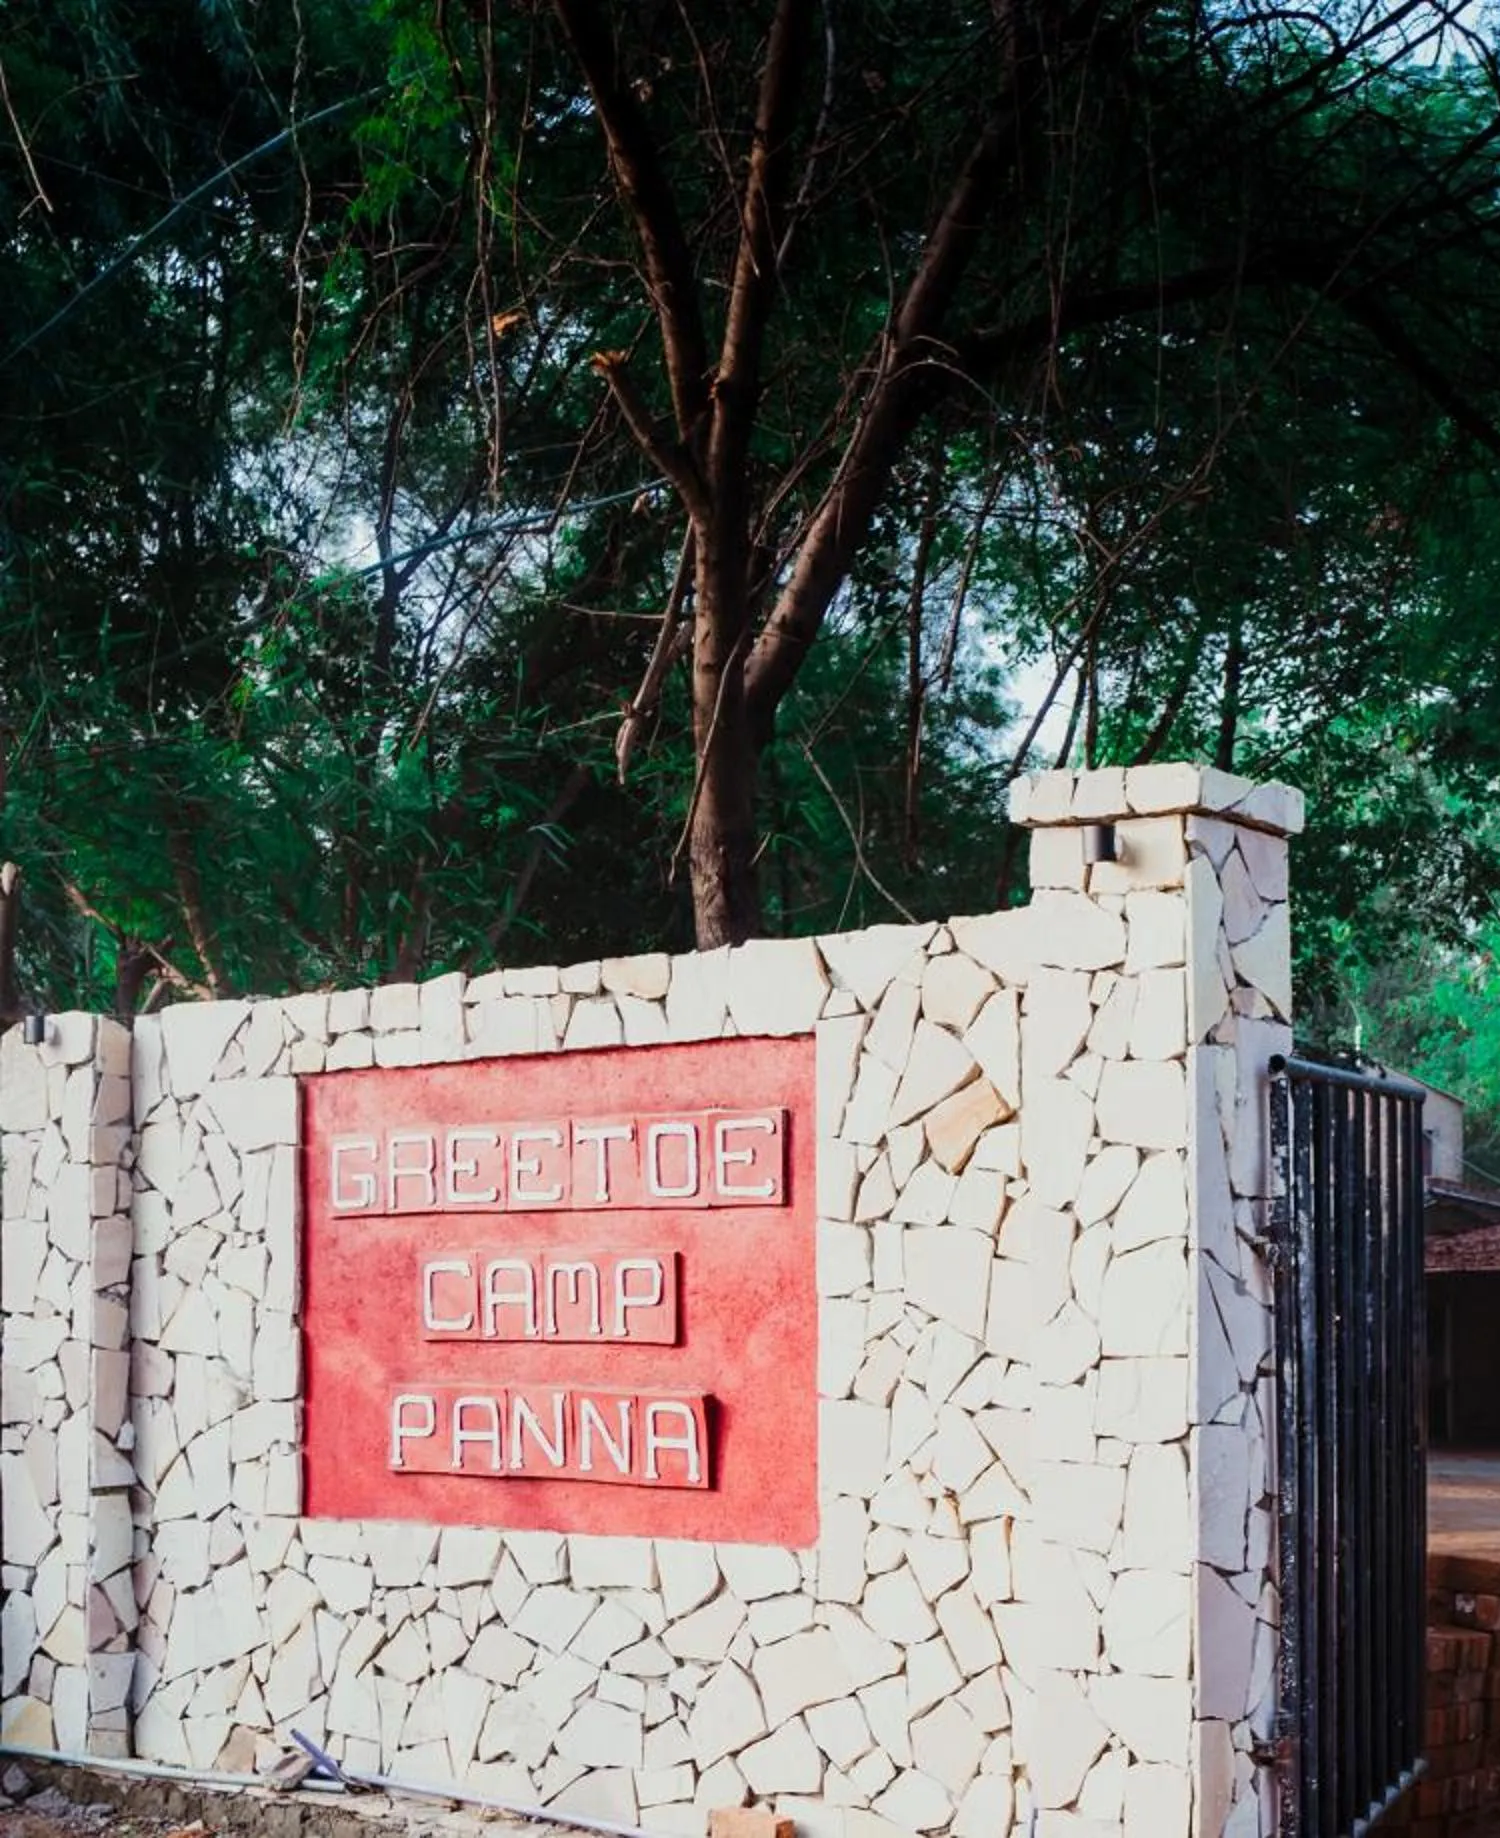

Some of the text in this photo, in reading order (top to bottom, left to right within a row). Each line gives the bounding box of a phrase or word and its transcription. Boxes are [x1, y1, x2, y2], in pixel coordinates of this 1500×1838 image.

[330, 1119, 777, 1210] GREETOE
[423, 1259, 664, 1337] CAMP
[389, 1393, 701, 1484] PANNA
